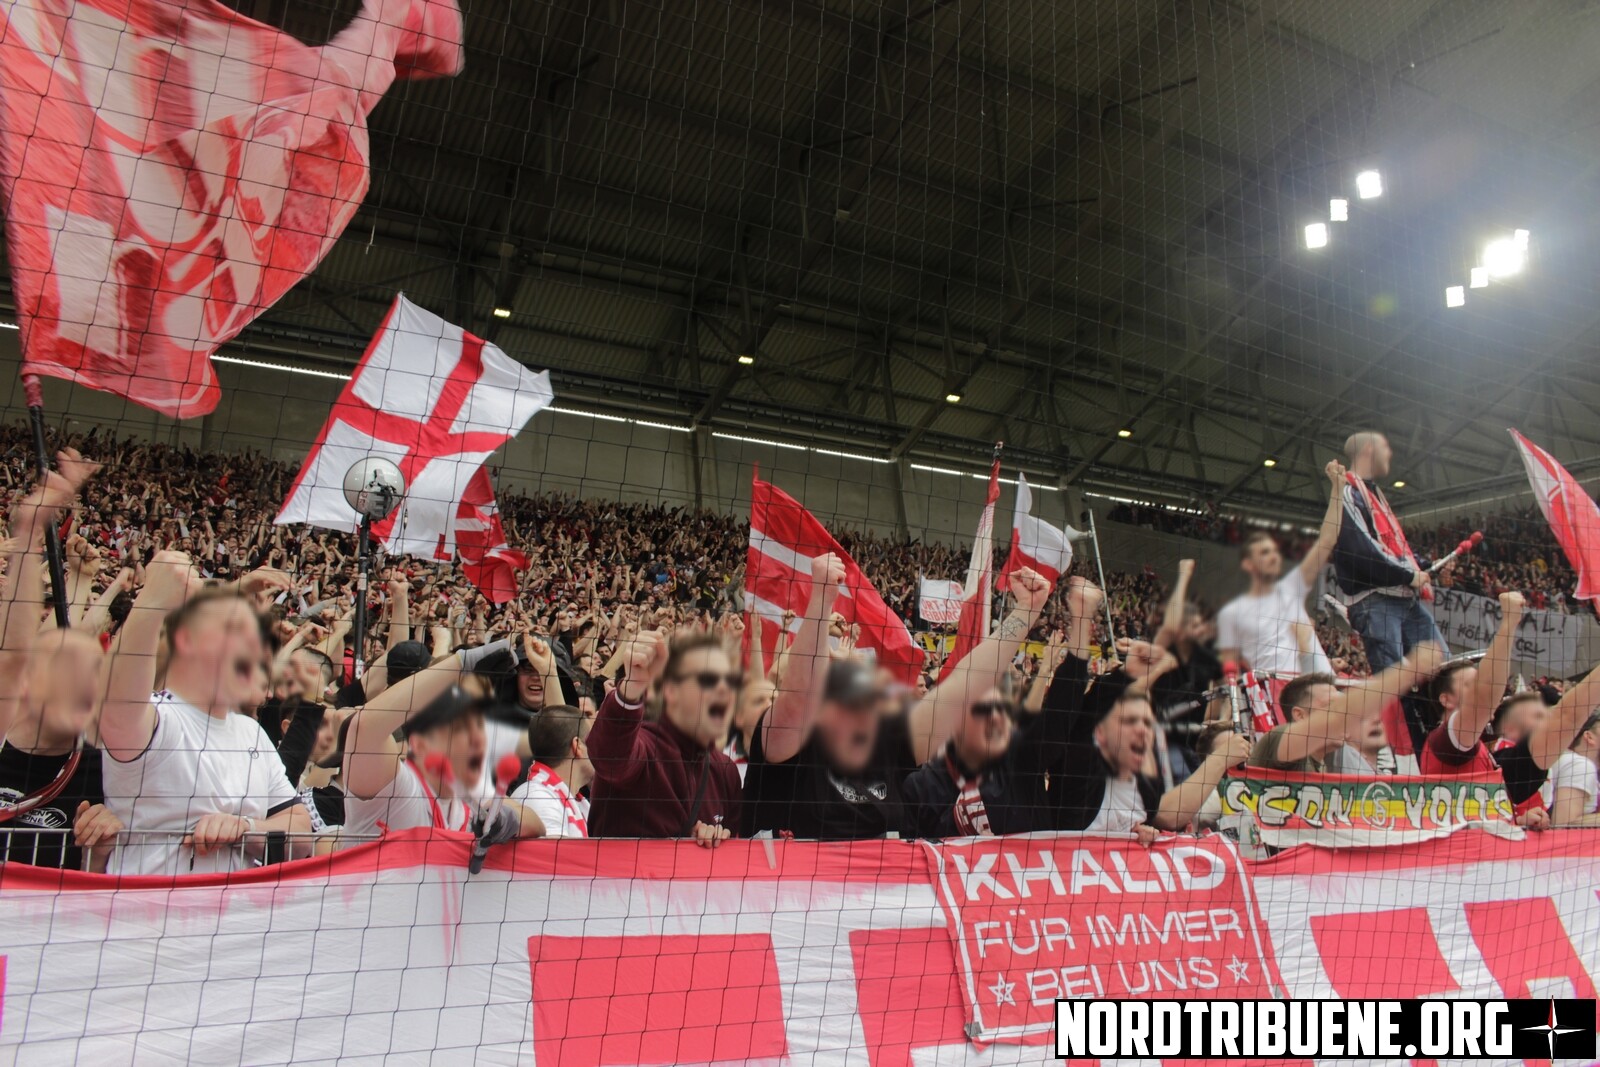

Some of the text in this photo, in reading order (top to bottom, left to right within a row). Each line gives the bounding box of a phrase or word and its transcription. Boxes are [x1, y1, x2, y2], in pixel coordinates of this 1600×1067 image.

[1433, 589, 1567, 635] DEN POAL!
[952, 846, 1226, 901] KHALID
[974, 908, 1244, 958] FÜR IMMER
[1026, 957, 1219, 1006] BEI UNS
